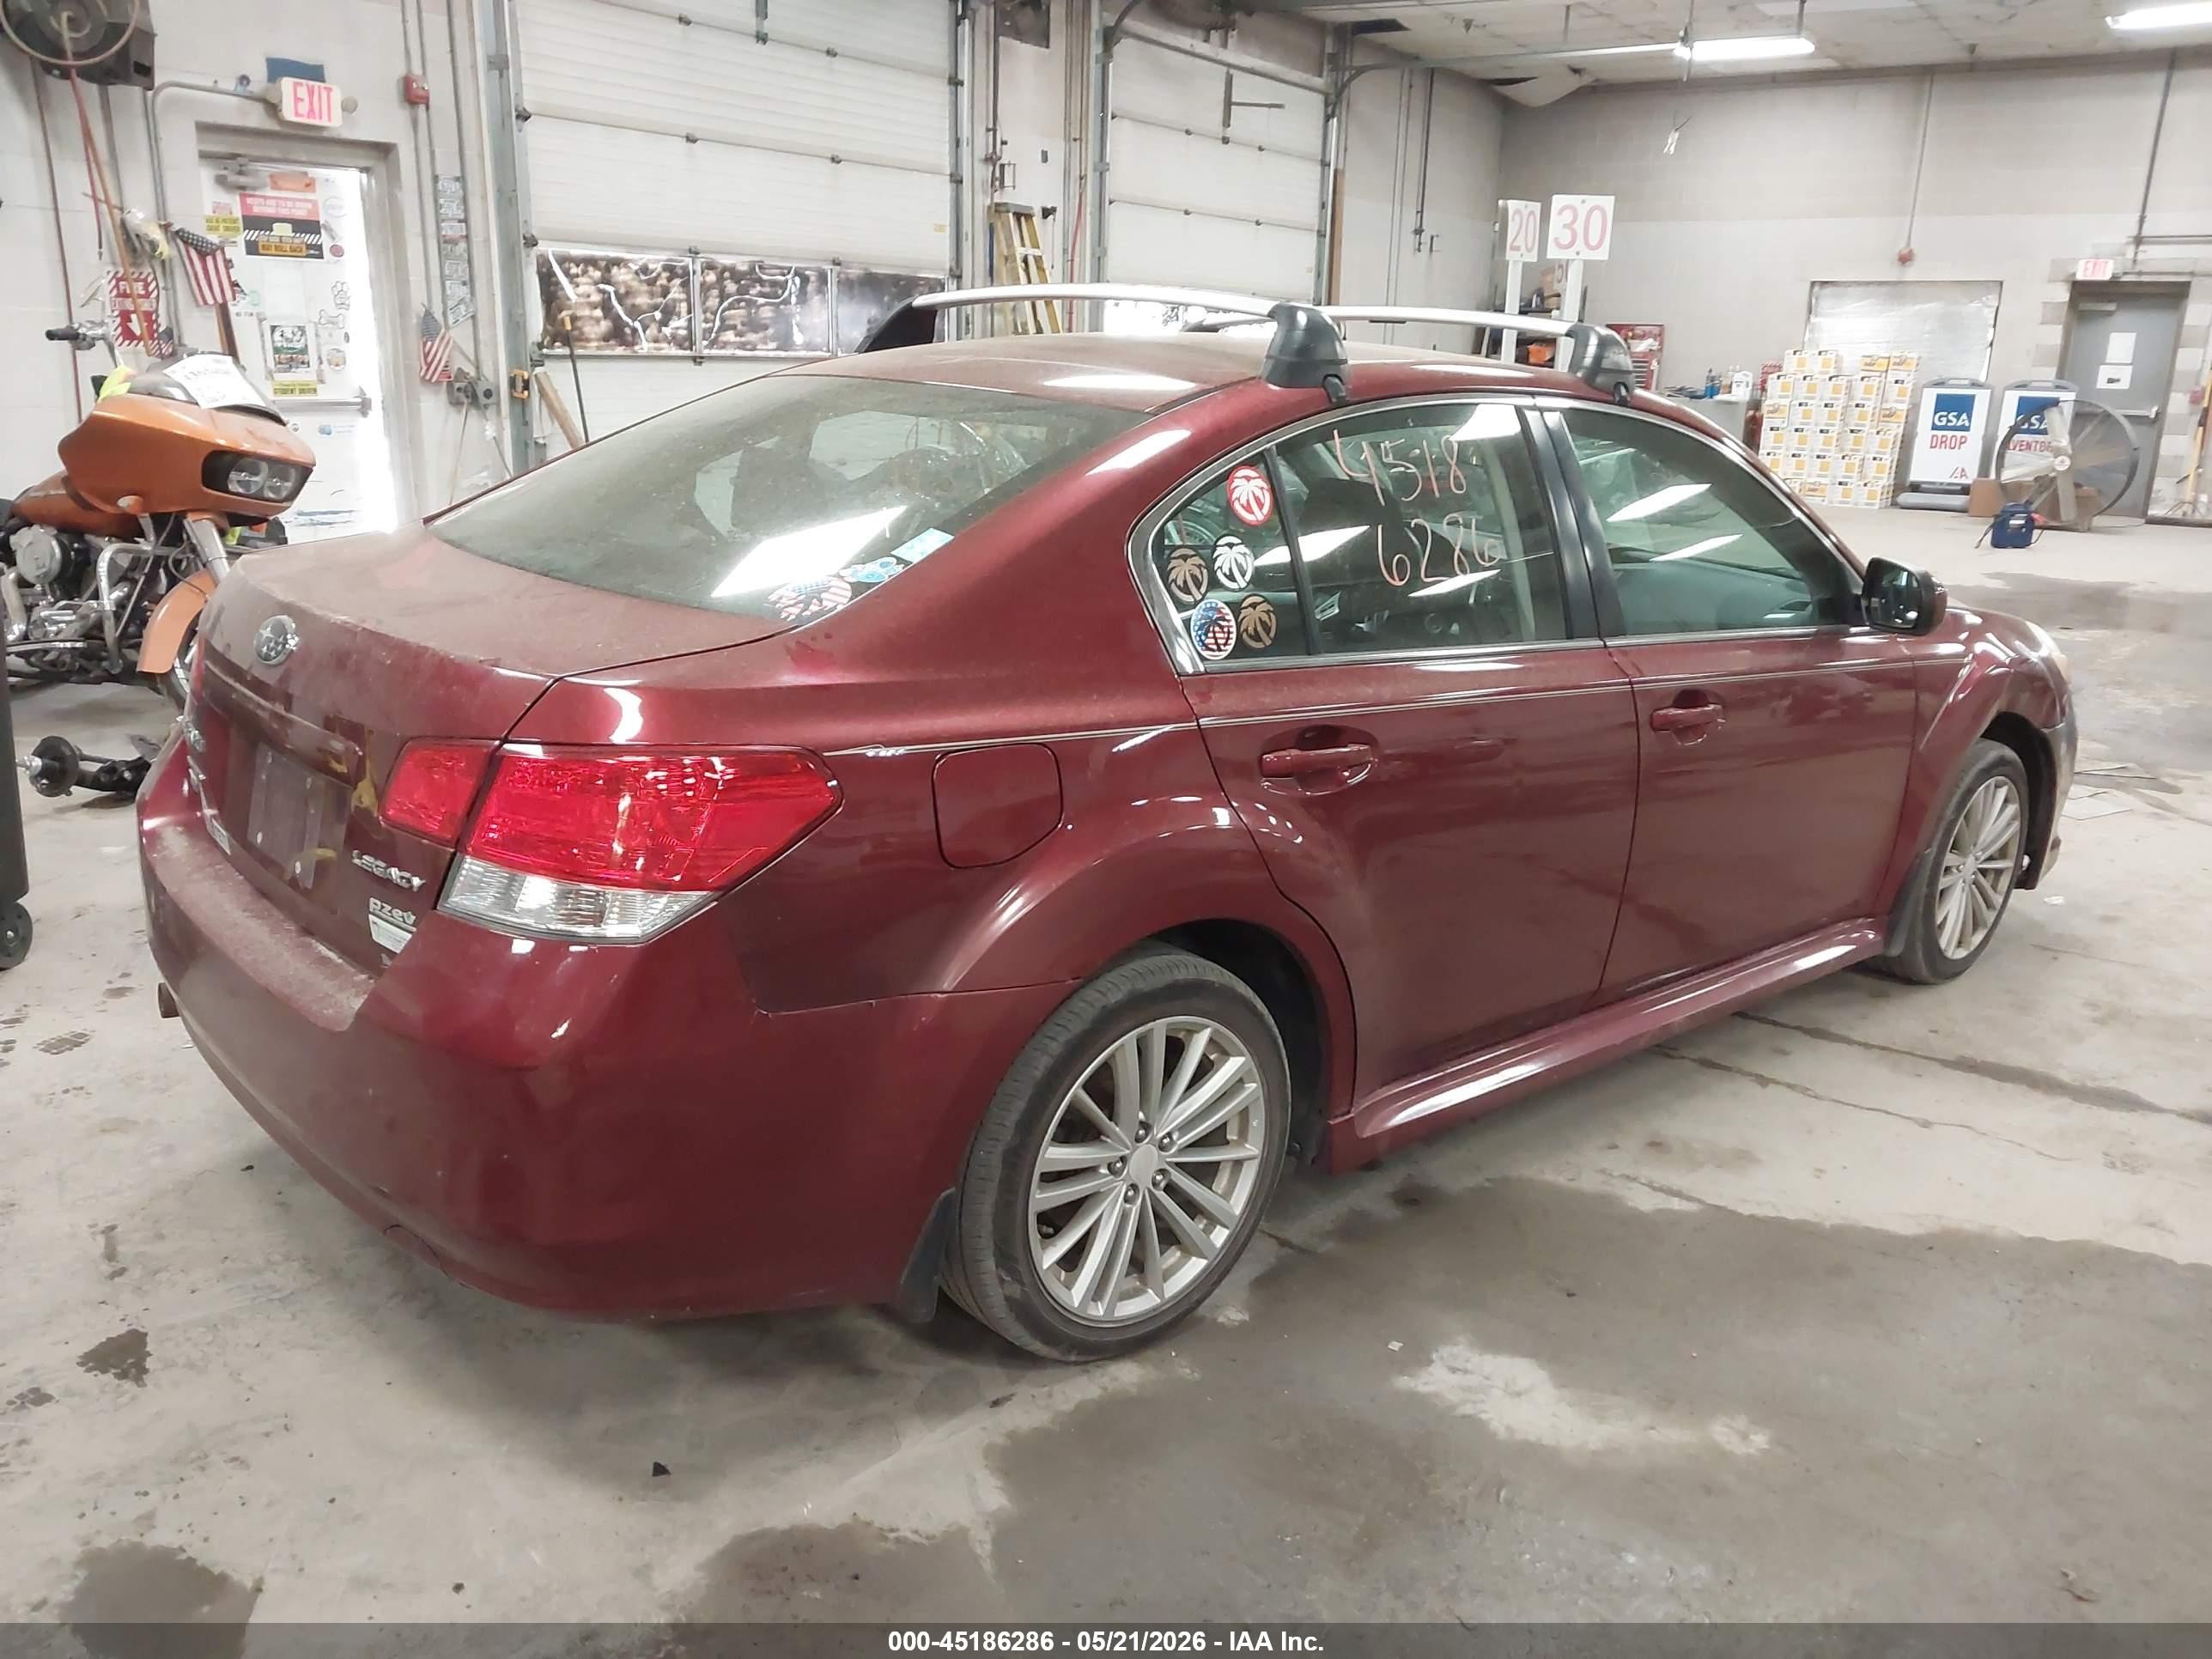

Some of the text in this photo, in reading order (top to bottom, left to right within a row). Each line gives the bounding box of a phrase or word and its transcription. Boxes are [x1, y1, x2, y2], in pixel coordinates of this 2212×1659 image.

[293, 82, 333, 123] EXIT
[1509, 208, 1537, 253] 20
[1553, 204, 1608, 251] 30
[1934, 411, 1970, 427] GSA
[1929, 434, 1968, 450] DROP
[1333, 429, 1467, 507] 4518
[1377, 513, 1500, 586] 6286
[351, 849, 426, 892] LEGACY
